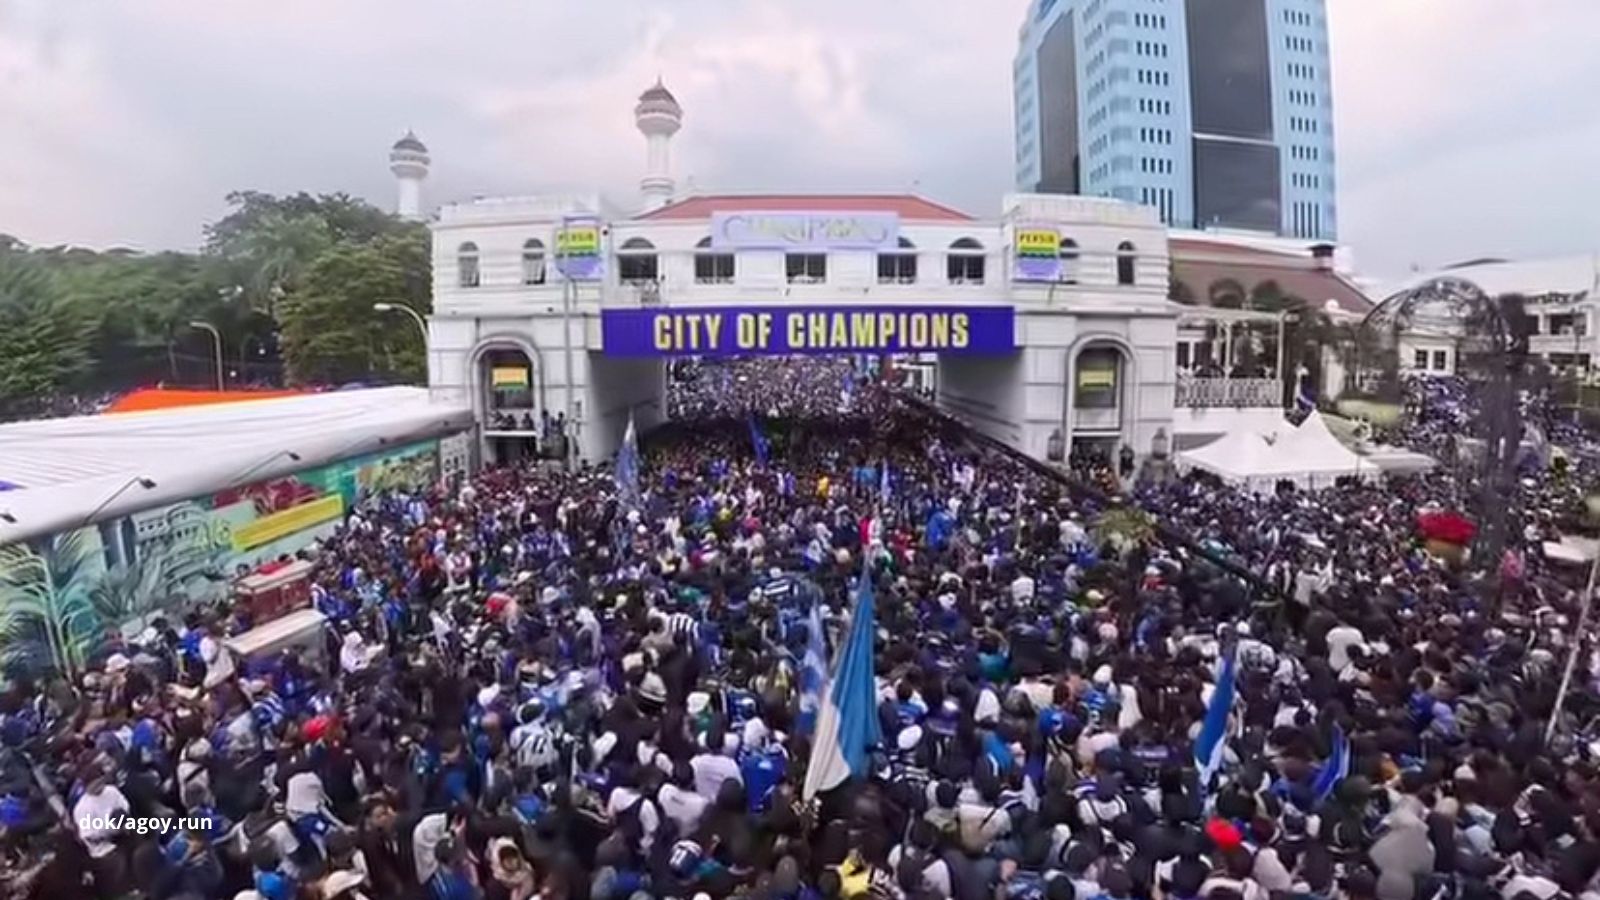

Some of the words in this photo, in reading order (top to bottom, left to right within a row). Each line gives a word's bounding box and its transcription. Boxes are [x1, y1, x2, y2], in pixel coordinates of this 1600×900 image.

[653, 312, 721, 350] CITY
[736, 313, 773, 349] OF
[787, 312, 970, 349] CHAMPIONS
